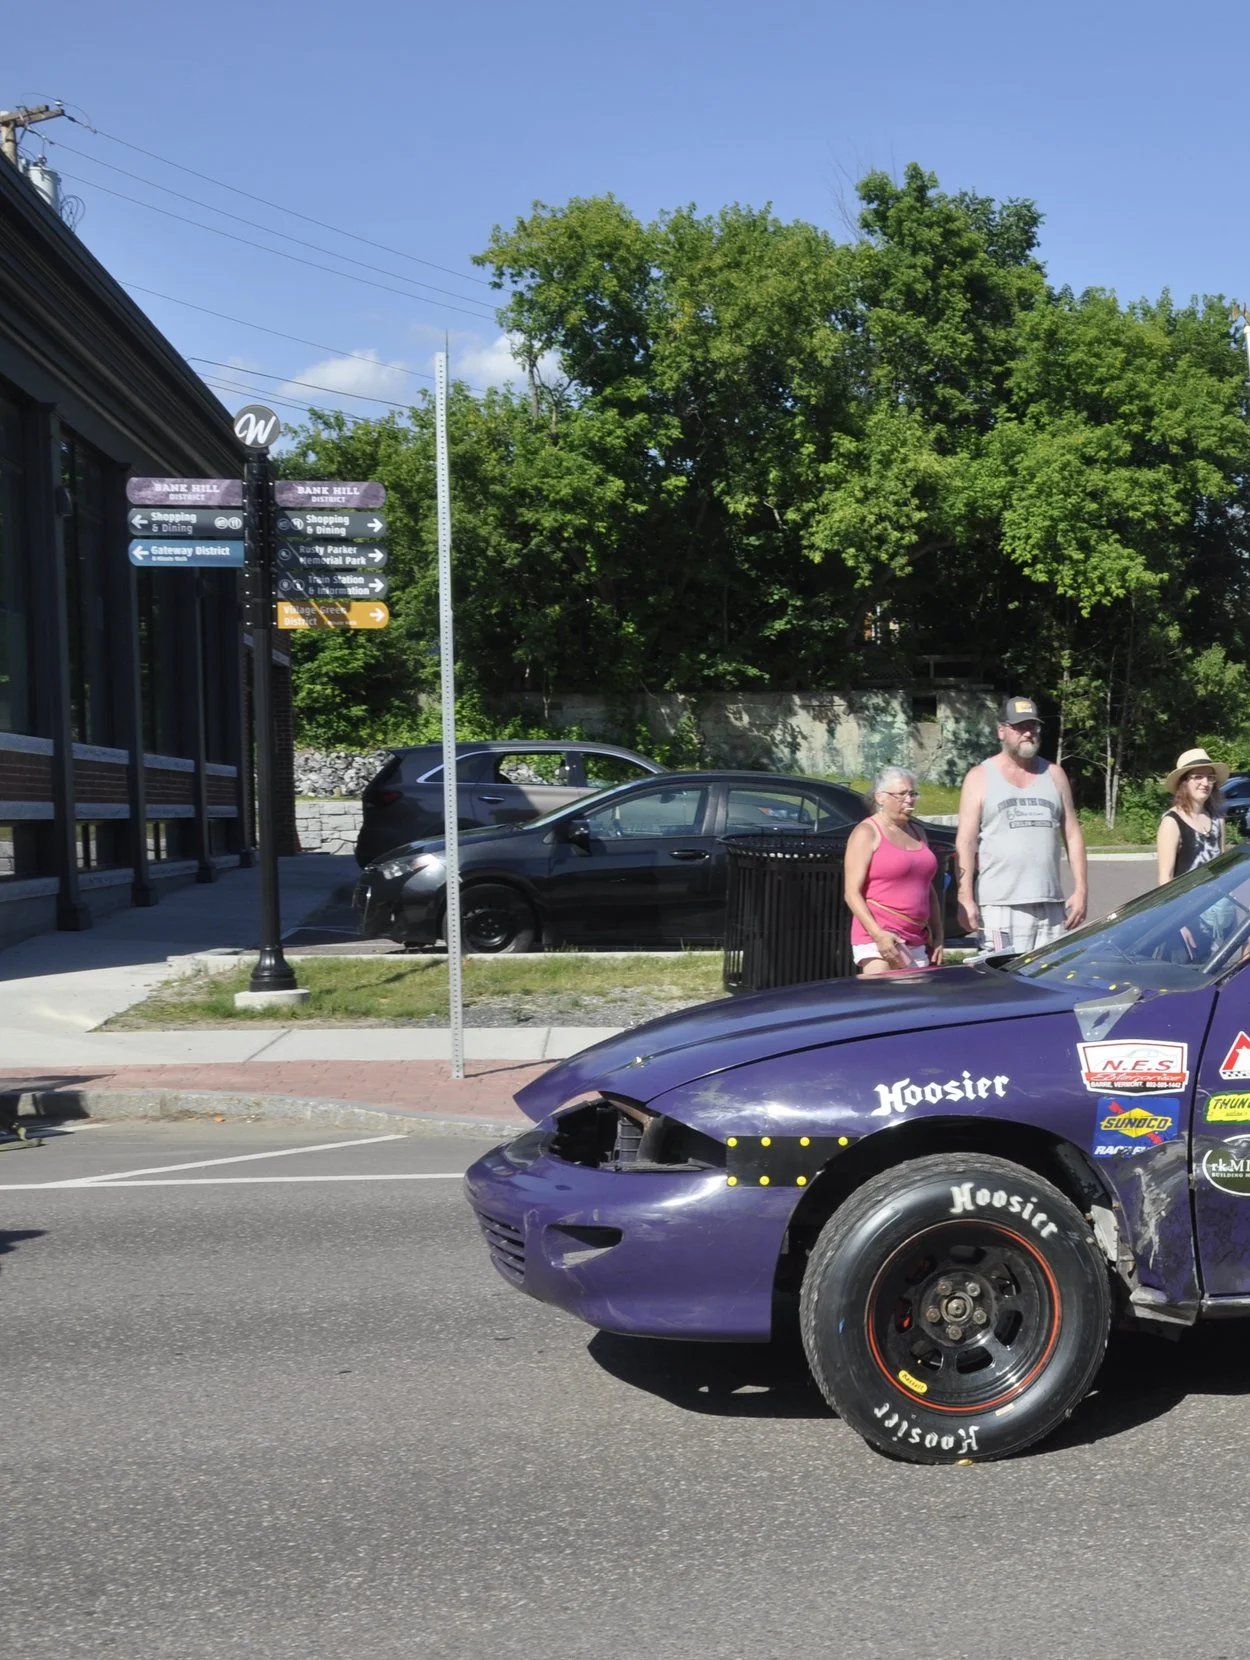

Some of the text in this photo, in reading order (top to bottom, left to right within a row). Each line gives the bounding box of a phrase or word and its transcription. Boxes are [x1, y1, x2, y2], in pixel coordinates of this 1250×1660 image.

[235, 413, 276, 445] W
[154, 483, 220, 493] BANK HILL
[297, 486, 360, 495] BANK HILL
[168, 493, 205, 501] DISTRICT
[150, 512, 197, 524] Shopping
[305, 514, 350, 526] Shopping
[151, 524, 193, 535] & Dining
[306, 526, 347, 537] & Dining
[150, 545, 230, 557] Gateway District
[299, 545, 358, 556] Rusty Parker
[299, 556, 366, 566] Memorial Park
[307, 574, 365, 585] Train Station
[308, 585, 370, 595] & Information
[283, 605, 347, 616] Village Green
[283, 617, 317, 626] District
[870, 1070, 1010, 1117] Hoosier
[1104, 1117, 1169, 1129] SUNOCO
[950, 1182, 1059, 1239] Hoosier
[874, 1402, 980, 1454] Hoosier
